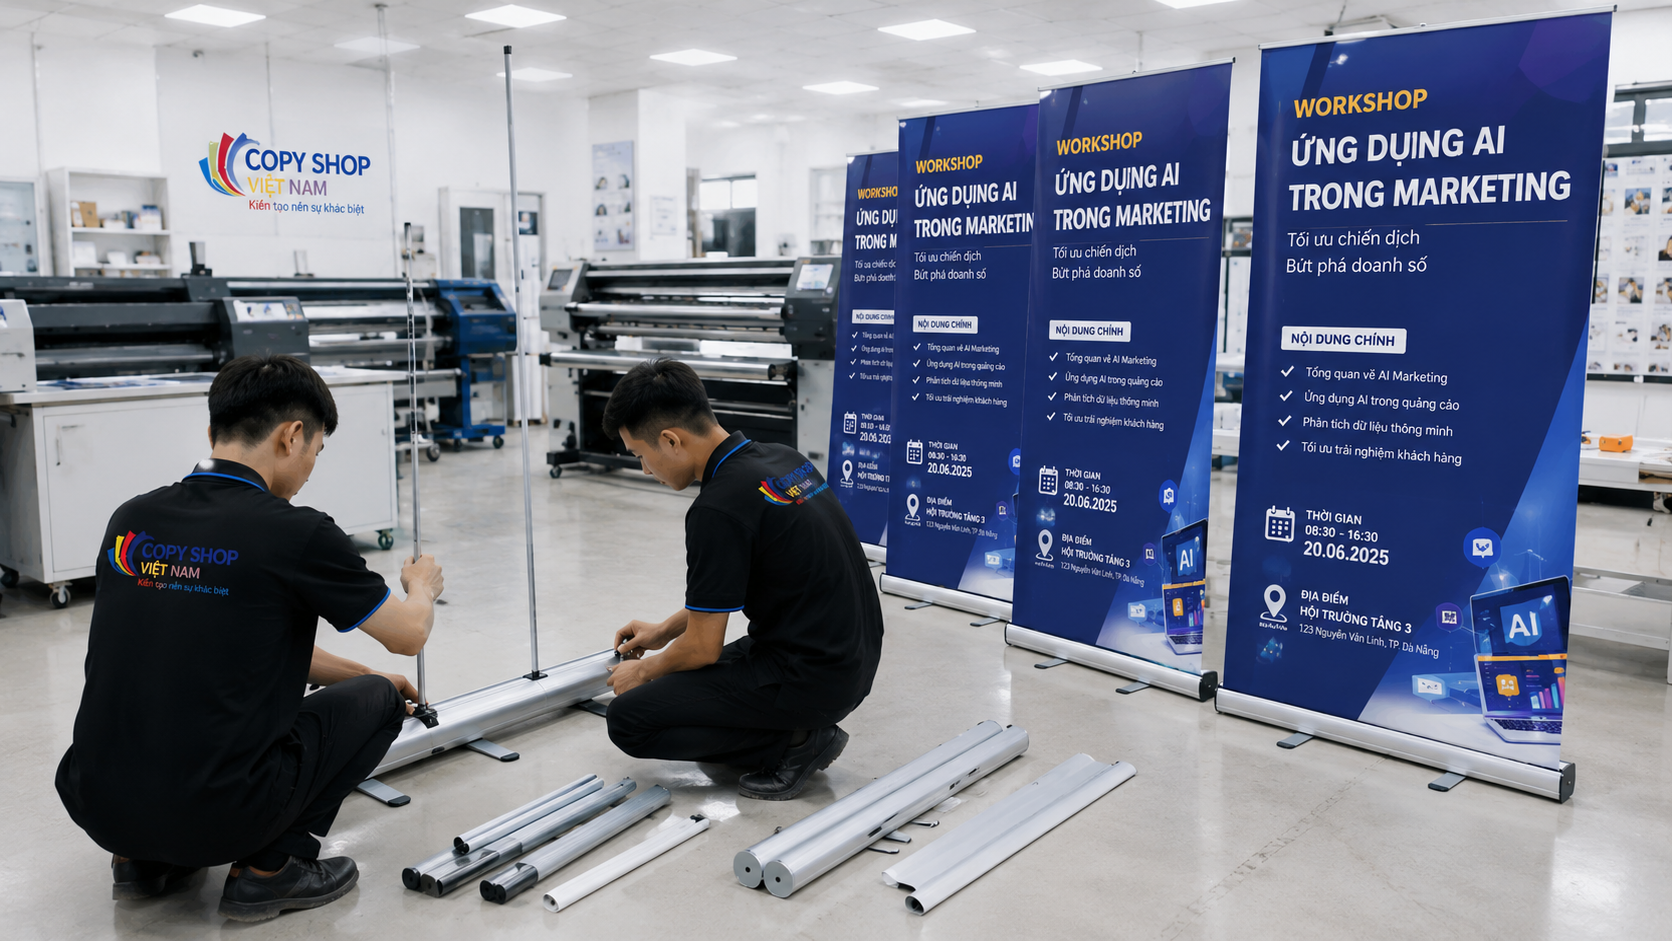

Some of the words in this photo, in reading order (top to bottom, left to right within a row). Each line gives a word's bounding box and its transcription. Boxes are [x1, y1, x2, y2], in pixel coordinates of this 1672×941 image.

[1294, 88, 1428, 118] WORKSHOP
[1057, 131, 1143, 155] WORKSHOP
[1292, 133, 1357, 166] ỨNG
[1473, 125, 1505, 155] AI
[245, 149, 306, 172] COPY
[312, 153, 371, 176] SHOP
[916, 154, 983, 174] WORKSHOP
[247, 173, 285, 198] VIỆT
[289, 179, 327, 196] NAM
[1055, 168, 1095, 195] ỨNG
[1161, 162, 1180, 186] AI
[857, 186, 898, 200] WORKSHO
[915, 184, 948, 208] ỨNG
[1002, 181, 1017, 201] AI
[1289, 180, 1384, 211] TRONG
[1393, 171, 1571, 206] MARKETING
[856, 208, 879, 226] ỨNG
[1054, 206, 1111, 230] TRONG
[1115, 198, 1211, 227] MARKETING
[914, 217, 962, 238] TRONG
[966, 212, 1034, 236] MARKETIN
[855, 234, 886, 250] TRONG
[1287, 232, 1309, 247] Tối
[1315, 235, 1333, 247] ưu
[1338, 229, 1380, 246] chiến
[1385, 229, 1419, 248] dịch
[1085, 244, 1112, 258] chiến
[948, 269, 974, 279] doanh
[1094, 266, 1126, 278] doanh
[1129, 264, 1141, 278] số
[1287, 258, 1313, 273] Bứt
[1318, 257, 1346, 276] phá
[1352, 257, 1402, 272] doanh
[1408, 255, 1428, 272] số
[1055, 324, 1070, 337] NỘI
[1072, 327, 1095, 335] DUNG
[1097, 324, 1123, 336] CHÍNH
[1291, 331, 1312, 346] NỘI
[1316, 334, 1351, 345] DUNG
[1354, 333, 1395, 346] CHÍNH
[1084, 355, 1101, 364] quan
[1121, 356, 1157, 368] Marketing
[1334, 370, 1360, 380] quan
[1378, 370, 1390, 380] AI
[1392, 371, 1448, 386] Marketing
[1328, 393, 1354, 407] dụng
[1357, 395, 1368, 405] AI
[1371, 396, 1399, 409] trong
[1391, 423, 1422, 437] thông
[1425, 426, 1453, 436] minh
[1355, 447, 1394, 460] nghiệm
[927, 462, 972, 478] 20.06.2025
[1063, 493, 1117, 513] 20.06.2025
[1306, 510, 1332, 522] THỜI
[1335, 513, 1362, 525] GIAN
[1305, 525, 1335, 537] 08:30
[1349, 530, 1378, 543] 16:30
[142, 543, 188, 561] COPY
[190, 547, 239, 565] SHOP
[1180, 549, 1193, 570] AI
[1303, 541, 1390, 566] 20.06.2025
[140, 560, 168, 578] VIỆT
[170, 565, 200, 579] NAM
[1125, 560, 1130, 568] 3
[1301, 590, 1319, 602] ĐỊA
[1299, 624, 1314, 634] 123
[1300, 605, 1319, 620] HỘI
[1404, 623, 1412, 634] 3
[1509, 611, 1539, 638] AI
